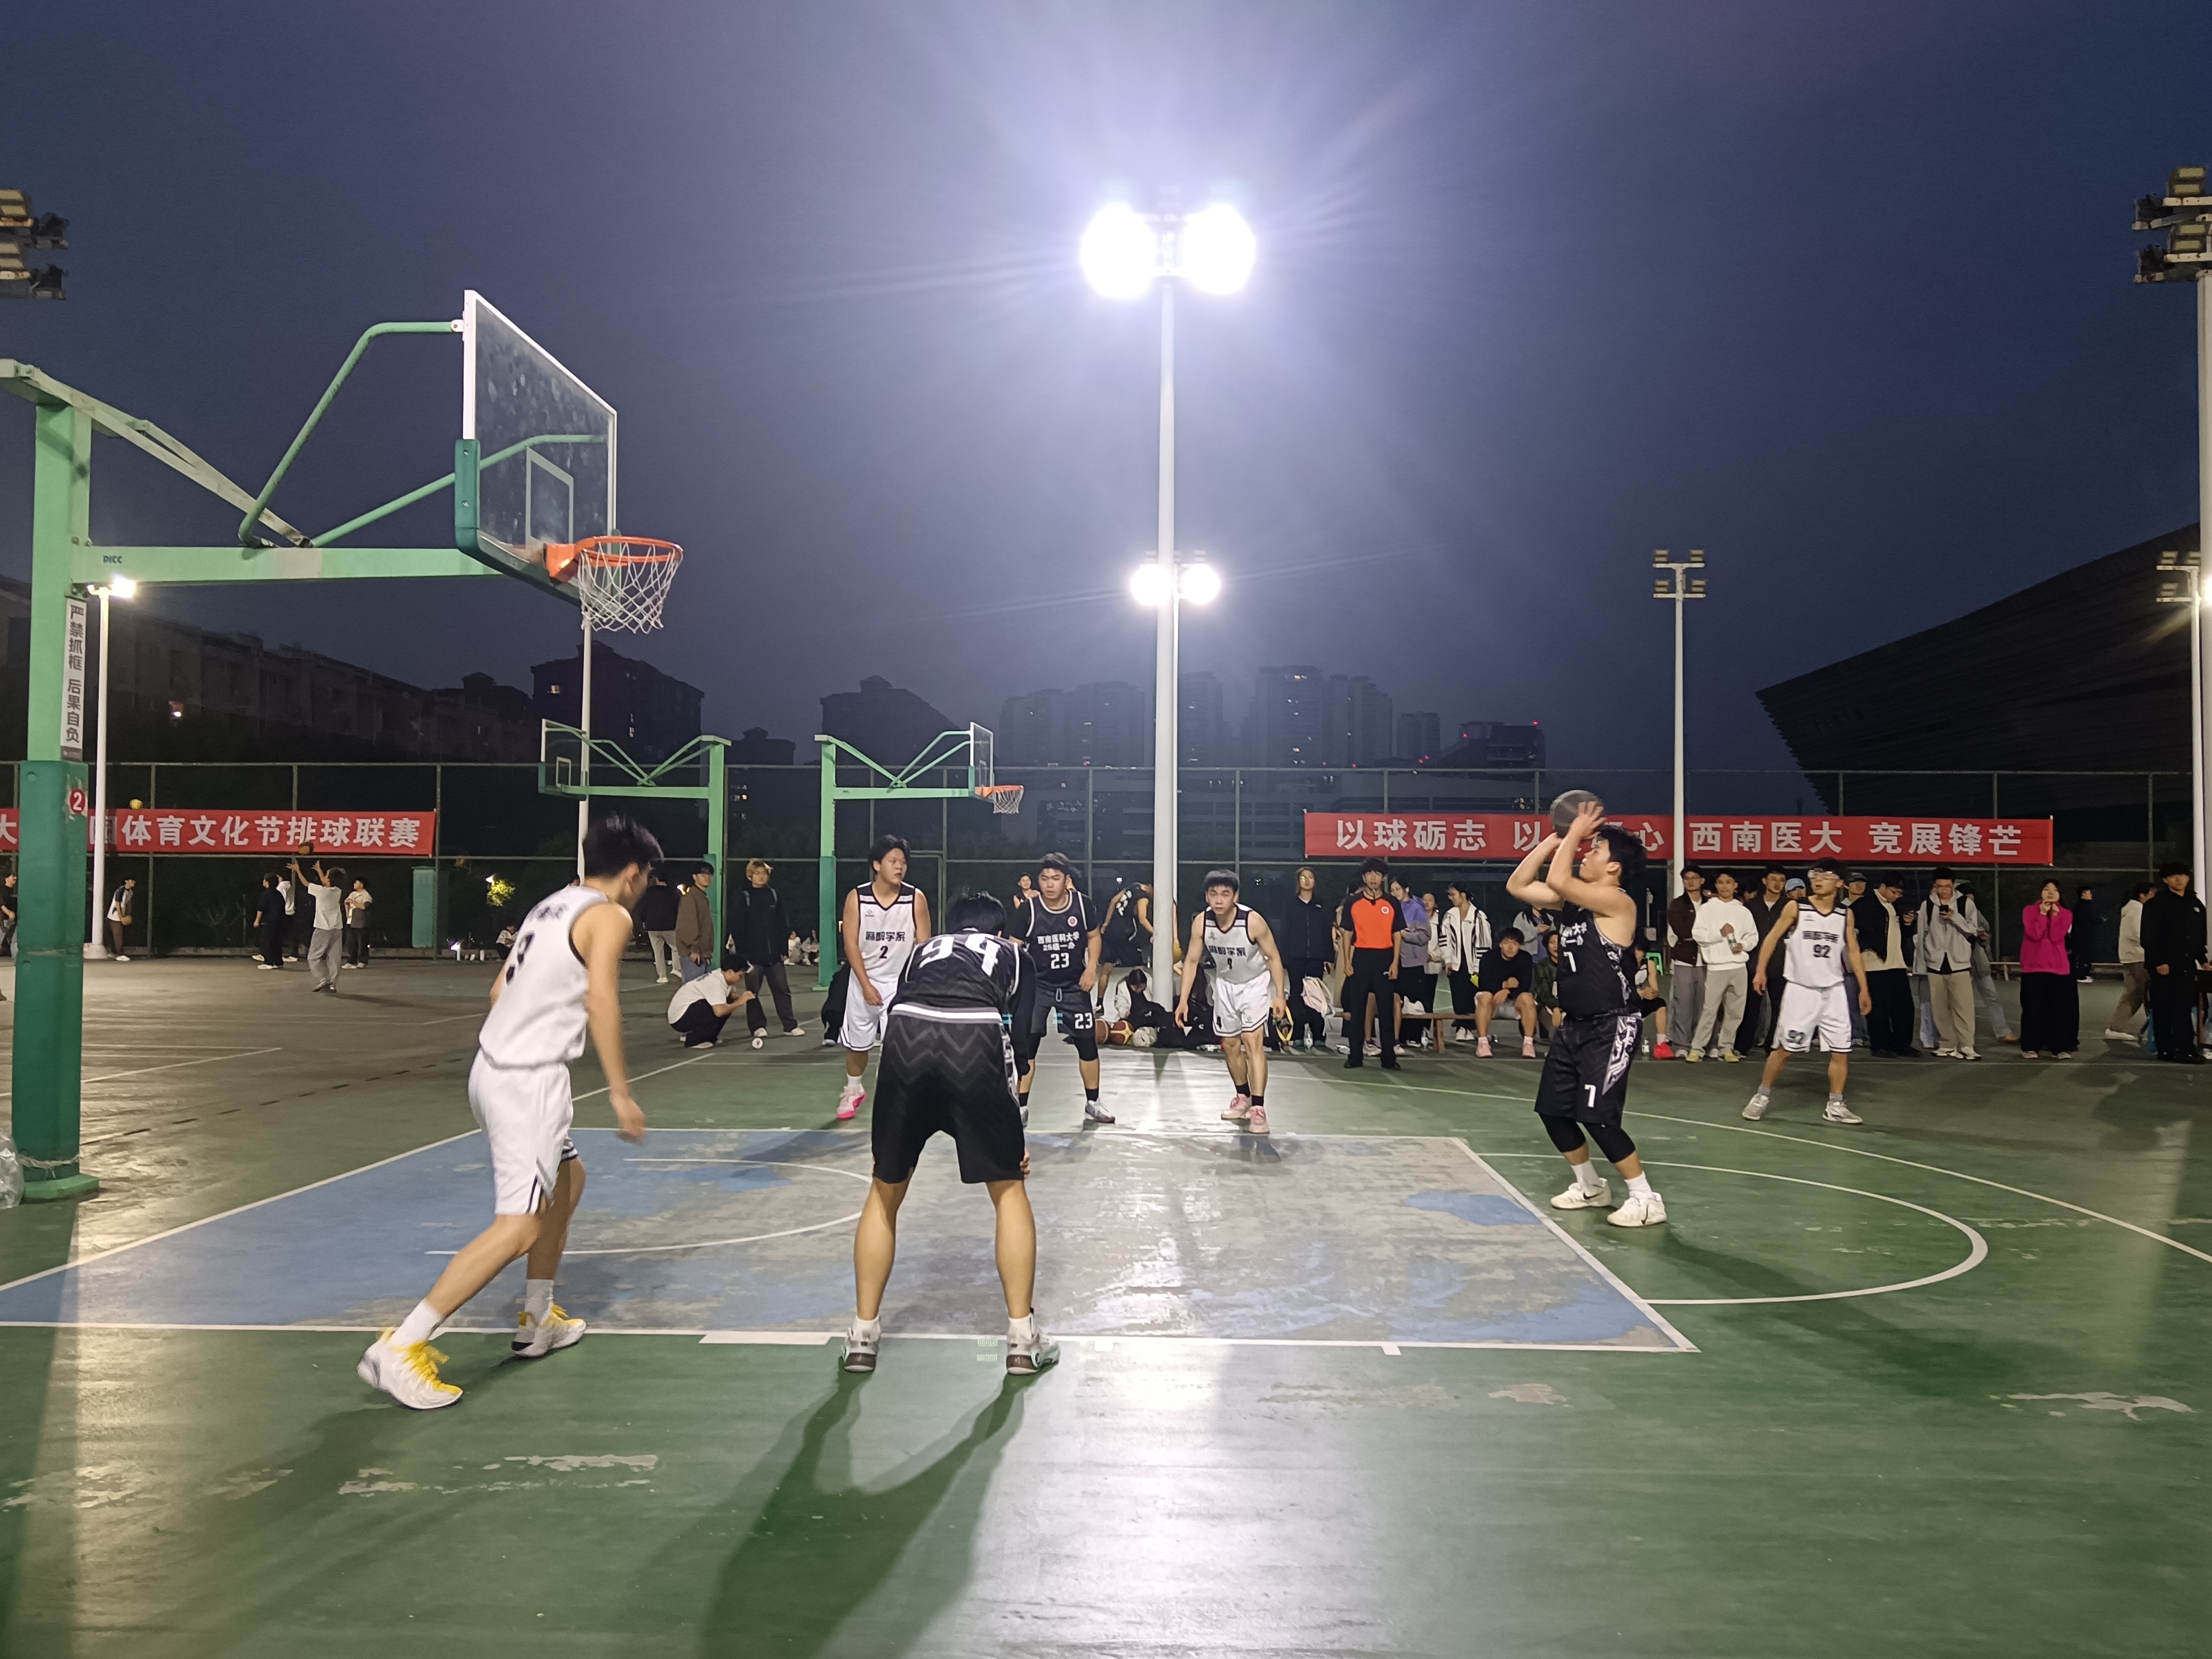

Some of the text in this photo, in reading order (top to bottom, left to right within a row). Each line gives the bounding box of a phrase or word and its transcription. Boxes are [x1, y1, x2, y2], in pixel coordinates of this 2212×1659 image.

[68, 604, 84, 671] 严禁抓框
[66, 678, 82, 743] 后果自负
[73, 792, 82, 811] 2
[1336, 819, 2021, 856] 以球砺志 以心 西南医大 竞展锋芒
[879, 945, 889, 959] 2
[1050, 952, 1070, 969] 23
[1813, 944, 1831, 959] 92
[1074, 1012, 1093, 1029] 23
[1584, 1084, 1596, 1108] 7
